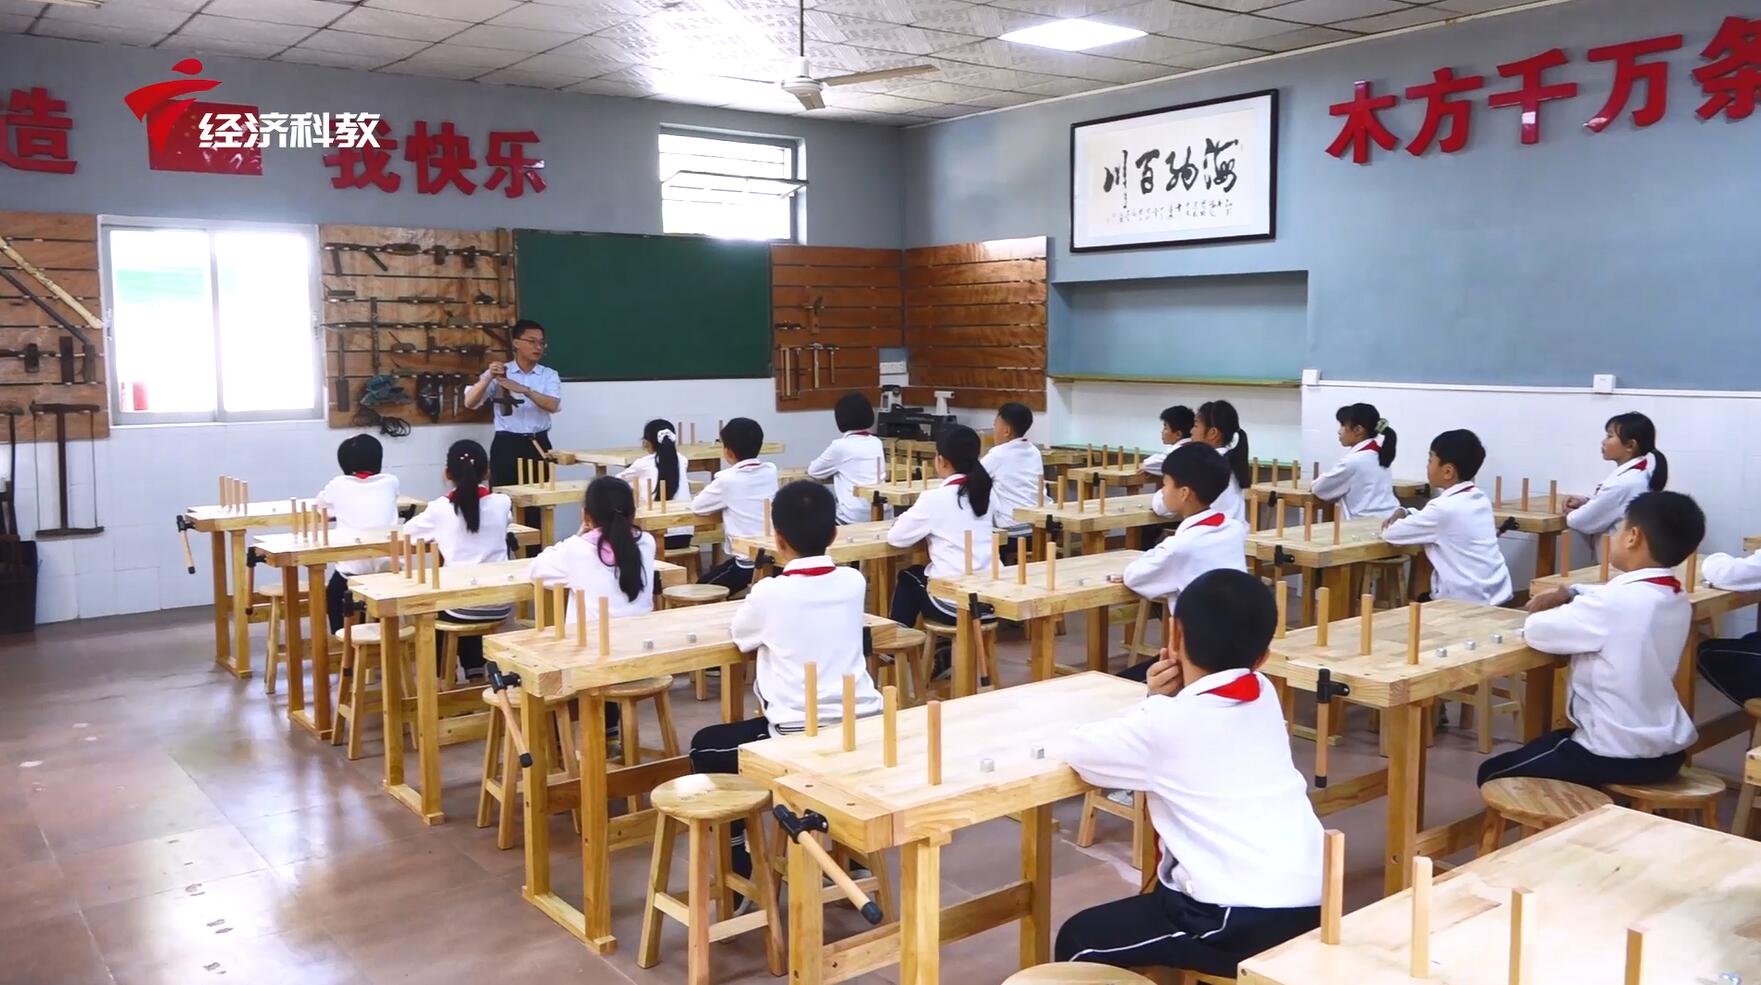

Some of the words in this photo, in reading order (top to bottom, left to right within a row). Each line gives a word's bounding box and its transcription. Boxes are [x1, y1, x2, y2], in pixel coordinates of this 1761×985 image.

[0, 87, 78, 175] 造
[1325, 16, 1761, 165] 木方千万条
